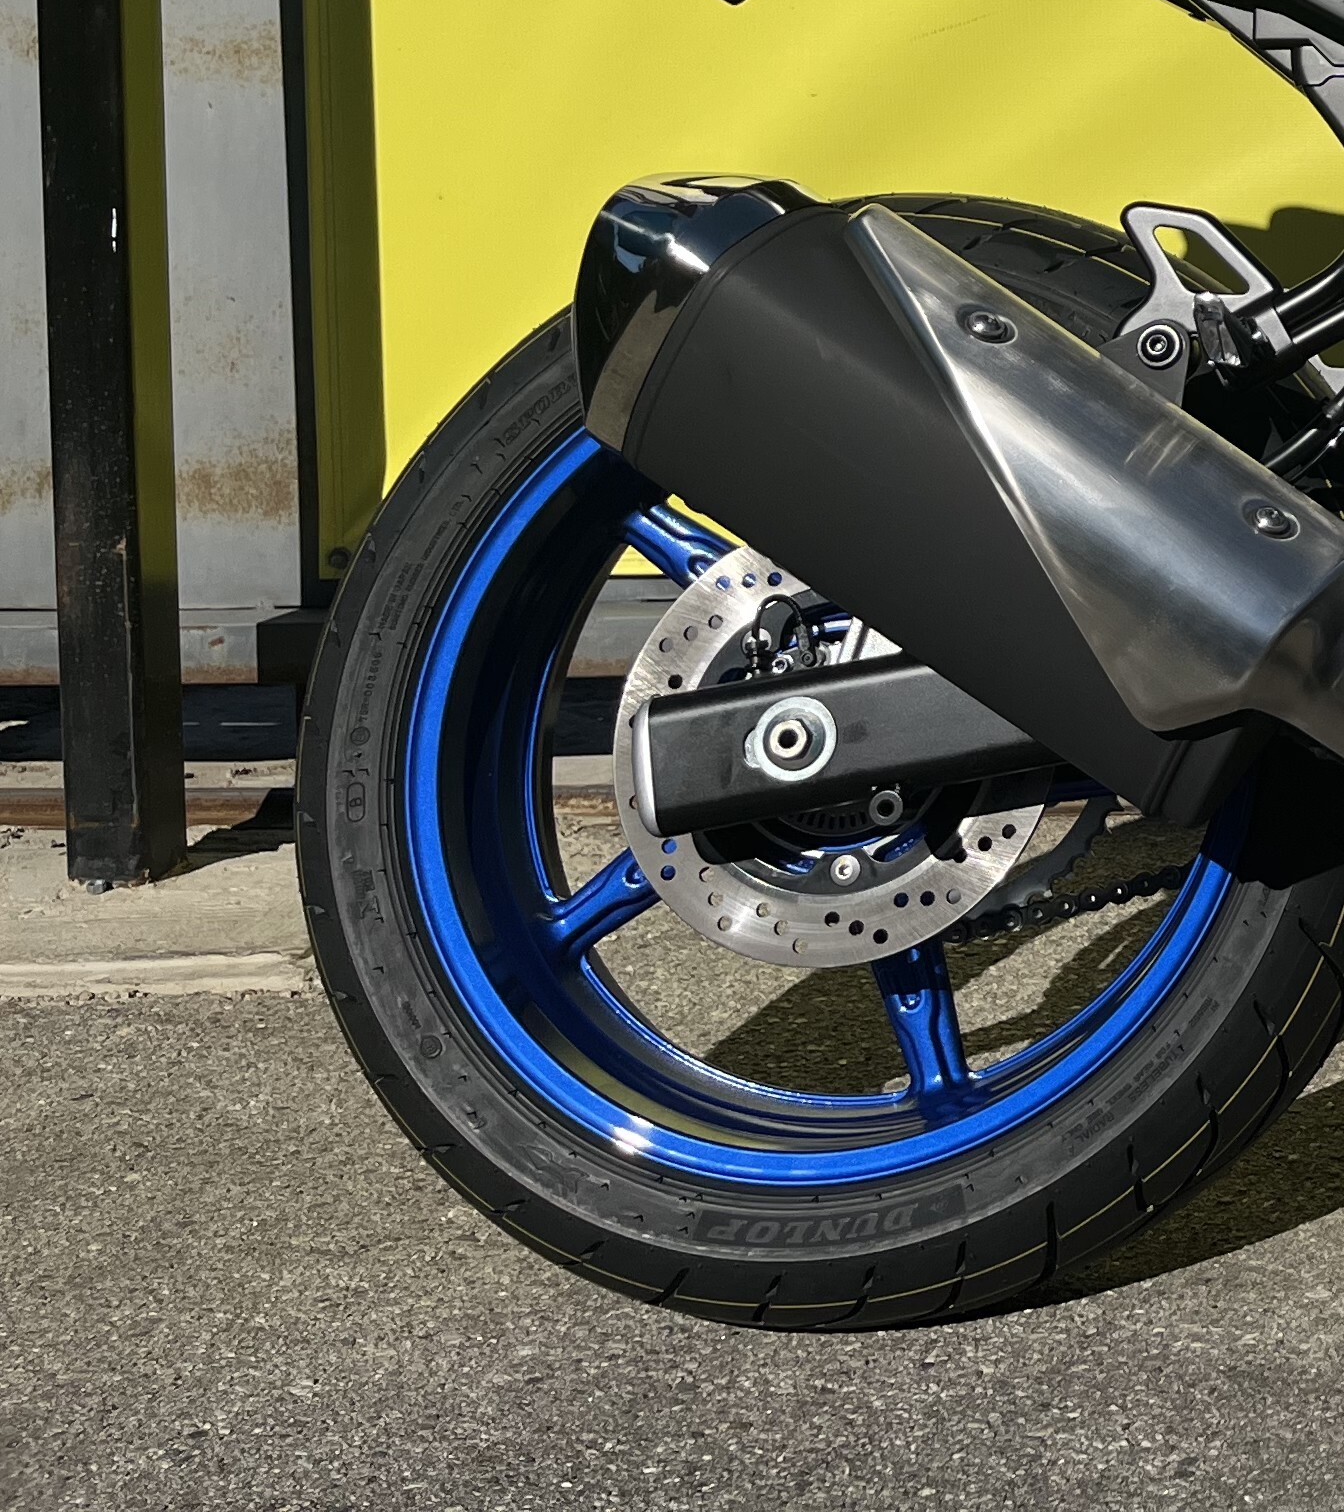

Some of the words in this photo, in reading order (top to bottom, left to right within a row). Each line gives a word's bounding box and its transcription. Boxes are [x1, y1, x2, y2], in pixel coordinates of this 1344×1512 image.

[1127, 1050, 1179, 1102] TUBELESS
[1077, 1111, 1115, 1143] RADIAL
[706, 1202, 919, 1244] DUNLOP
